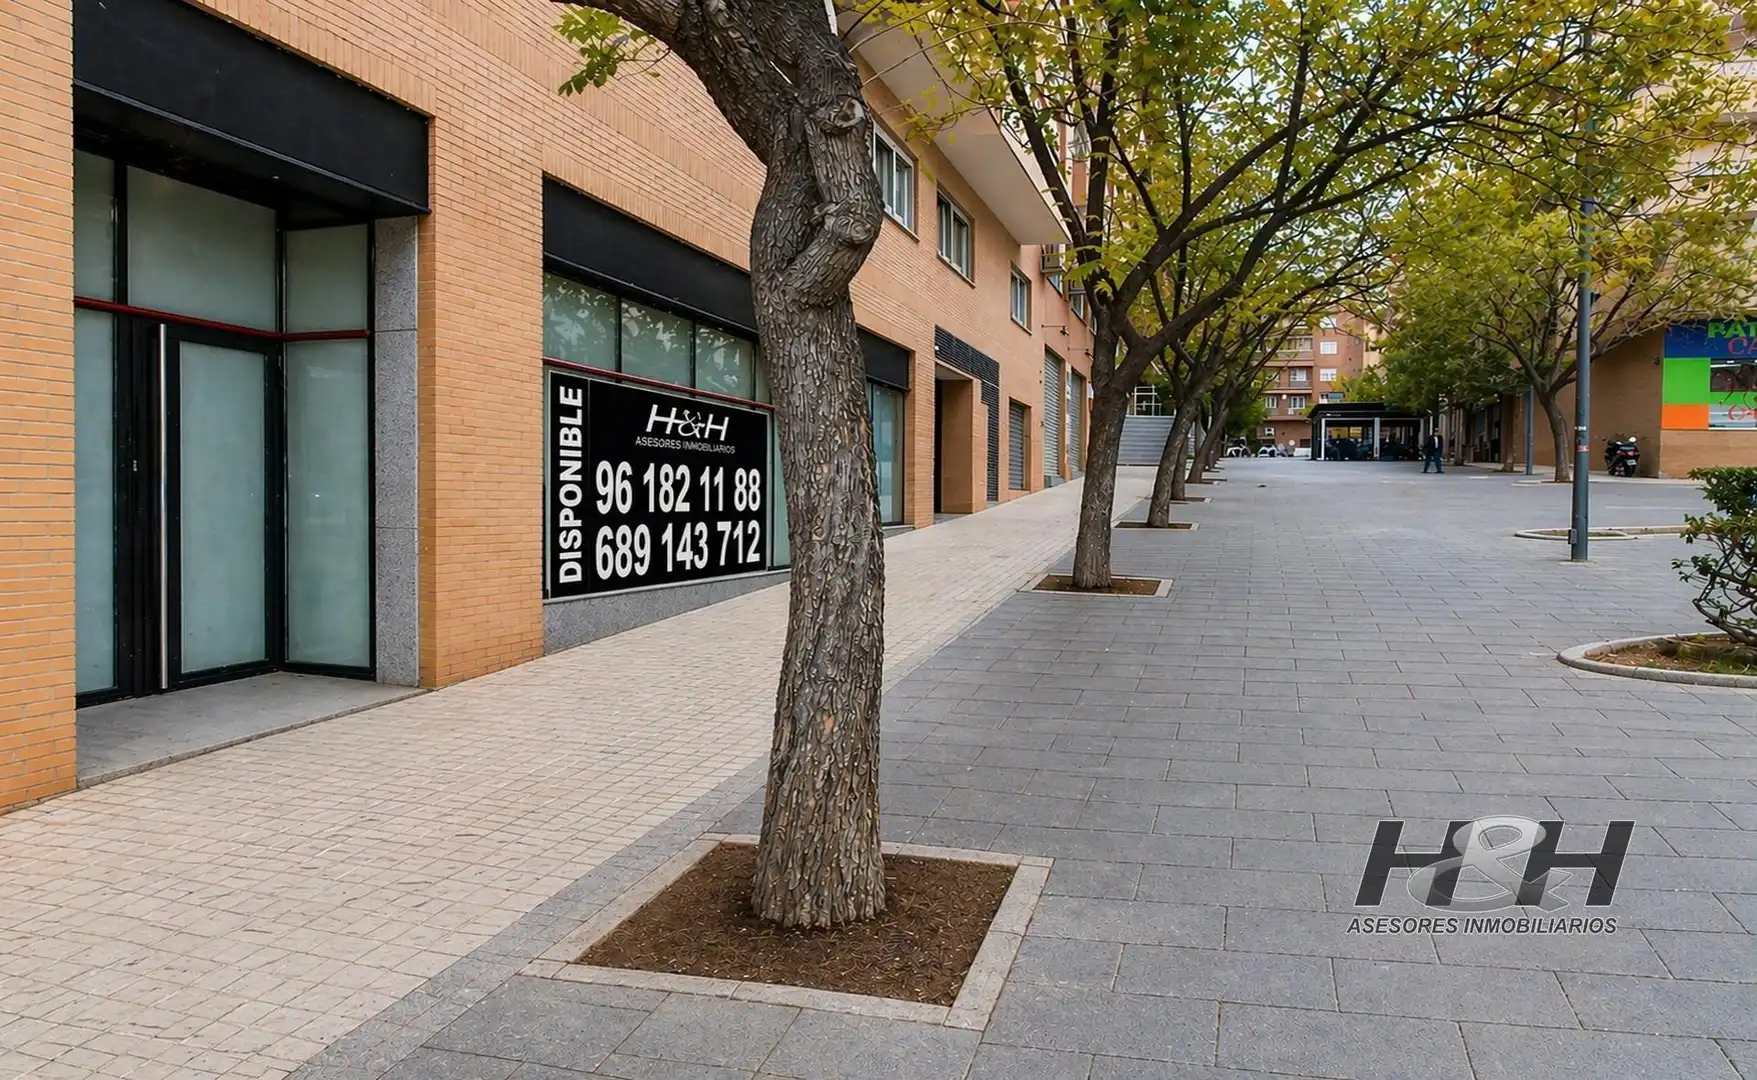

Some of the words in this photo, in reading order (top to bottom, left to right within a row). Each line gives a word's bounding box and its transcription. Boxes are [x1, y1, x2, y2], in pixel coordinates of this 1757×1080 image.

[635, 436, 682, 450] ASESORES
[682, 441, 736, 454] INMOBILIARIOS
[646, 404, 729, 441] H&H
[559, 386, 582, 583] DISPONIBLE
[596, 460, 633, 514] 96
[643, 463, 691, 513] 182
[699, 465, 724, 512] 11
[734, 467, 761, 512] 88
[595, 523, 651, 580] 689
[661, 522, 709, 572] 143
[717, 519, 761, 567] 712
